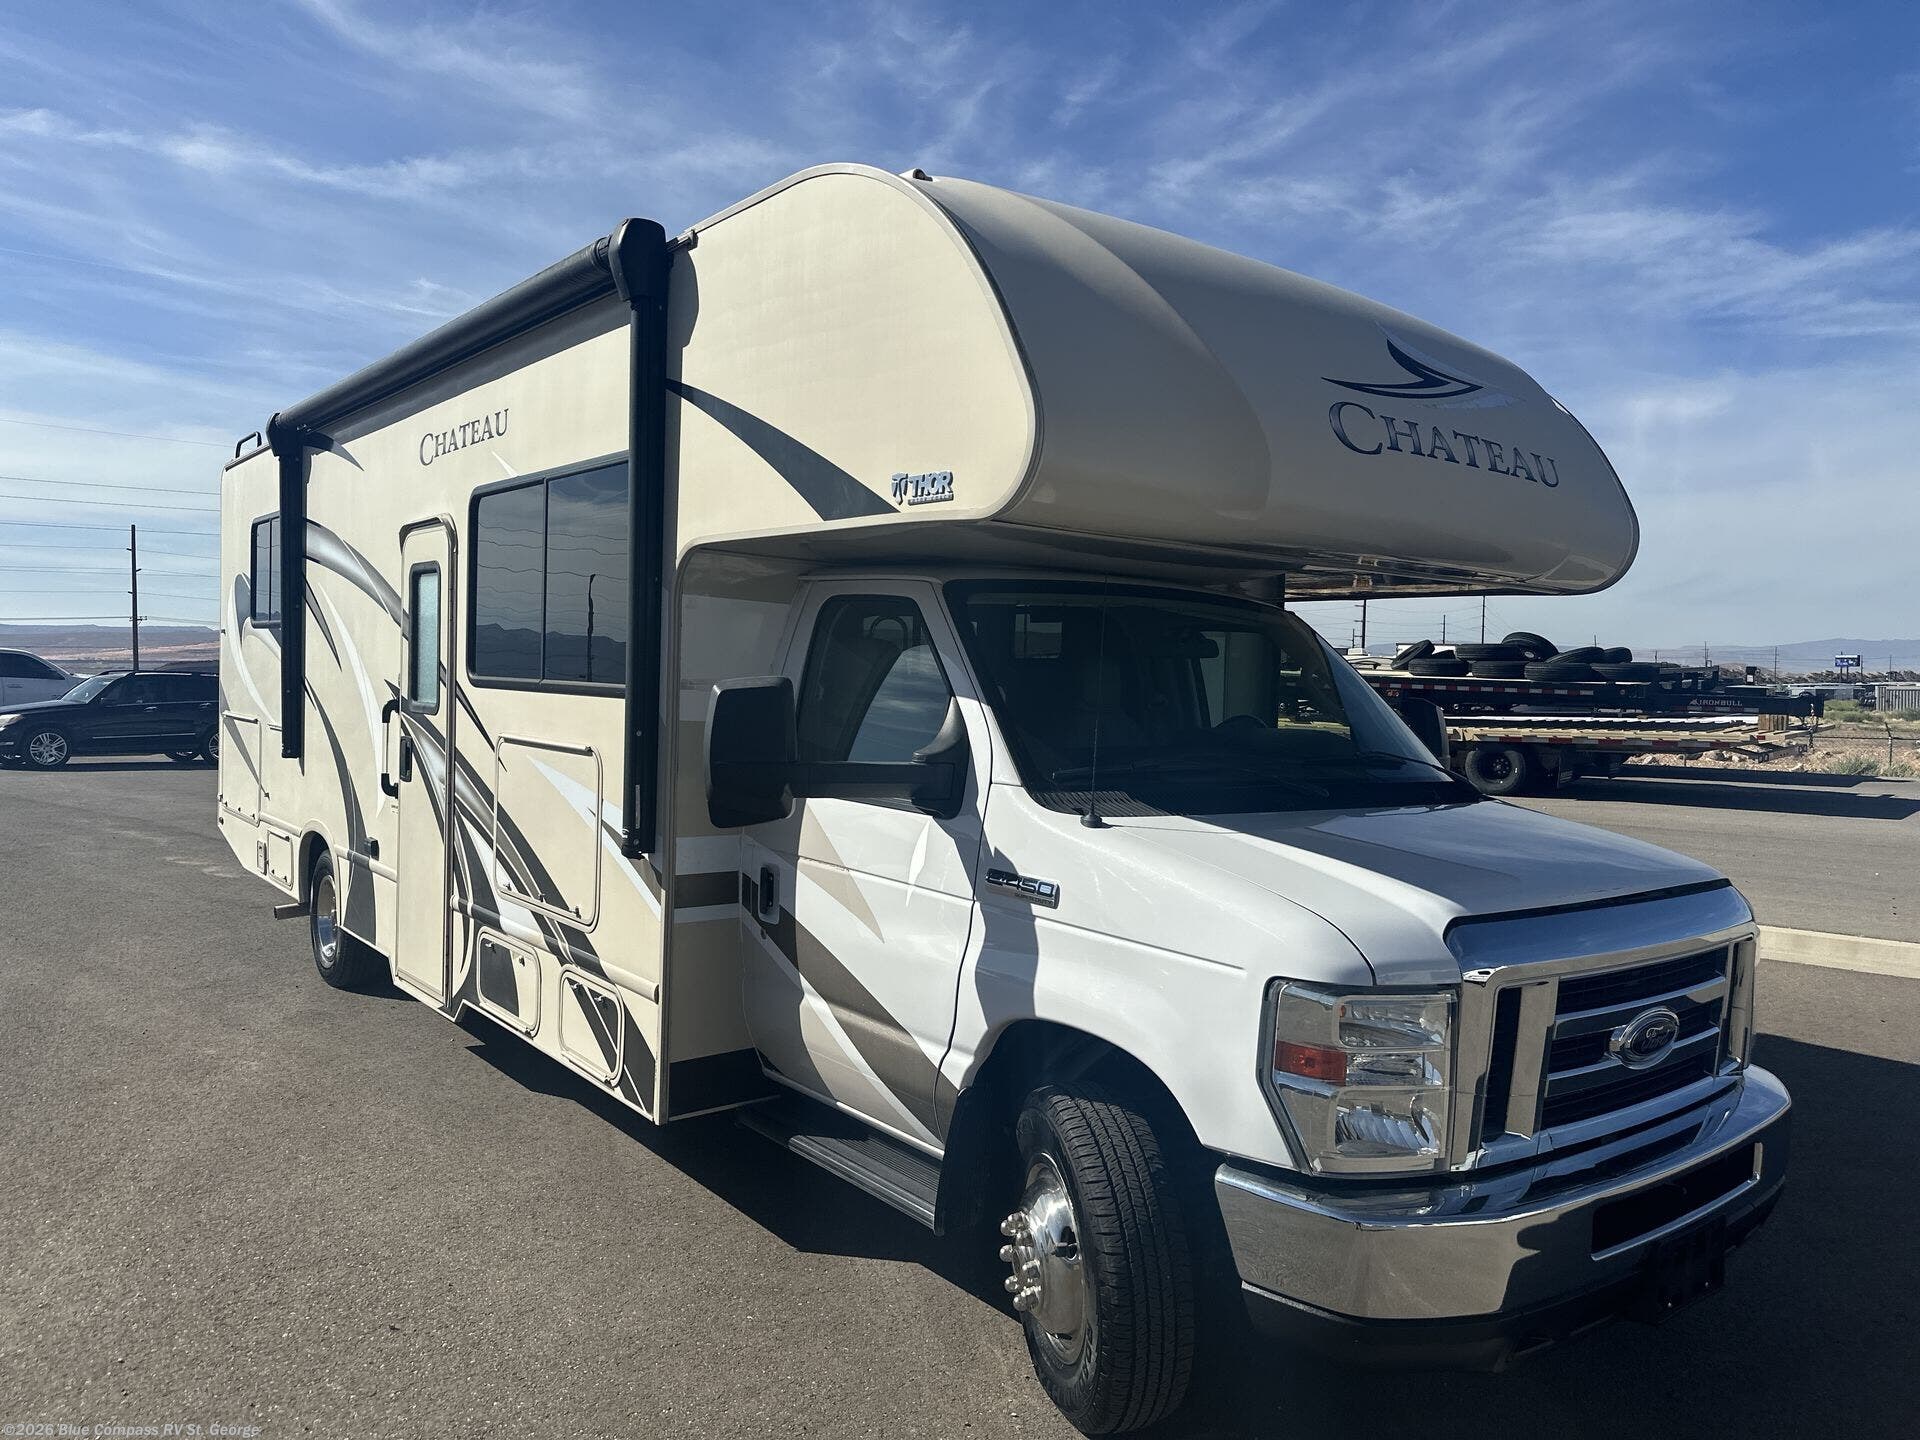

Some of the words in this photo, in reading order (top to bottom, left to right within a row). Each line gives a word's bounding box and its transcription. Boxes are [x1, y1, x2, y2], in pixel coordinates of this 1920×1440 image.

[419, 408, 509, 466] CHATEAU
[1328, 401, 1560, 488] CHATEAU
[908, 470, 953, 498] THOR
